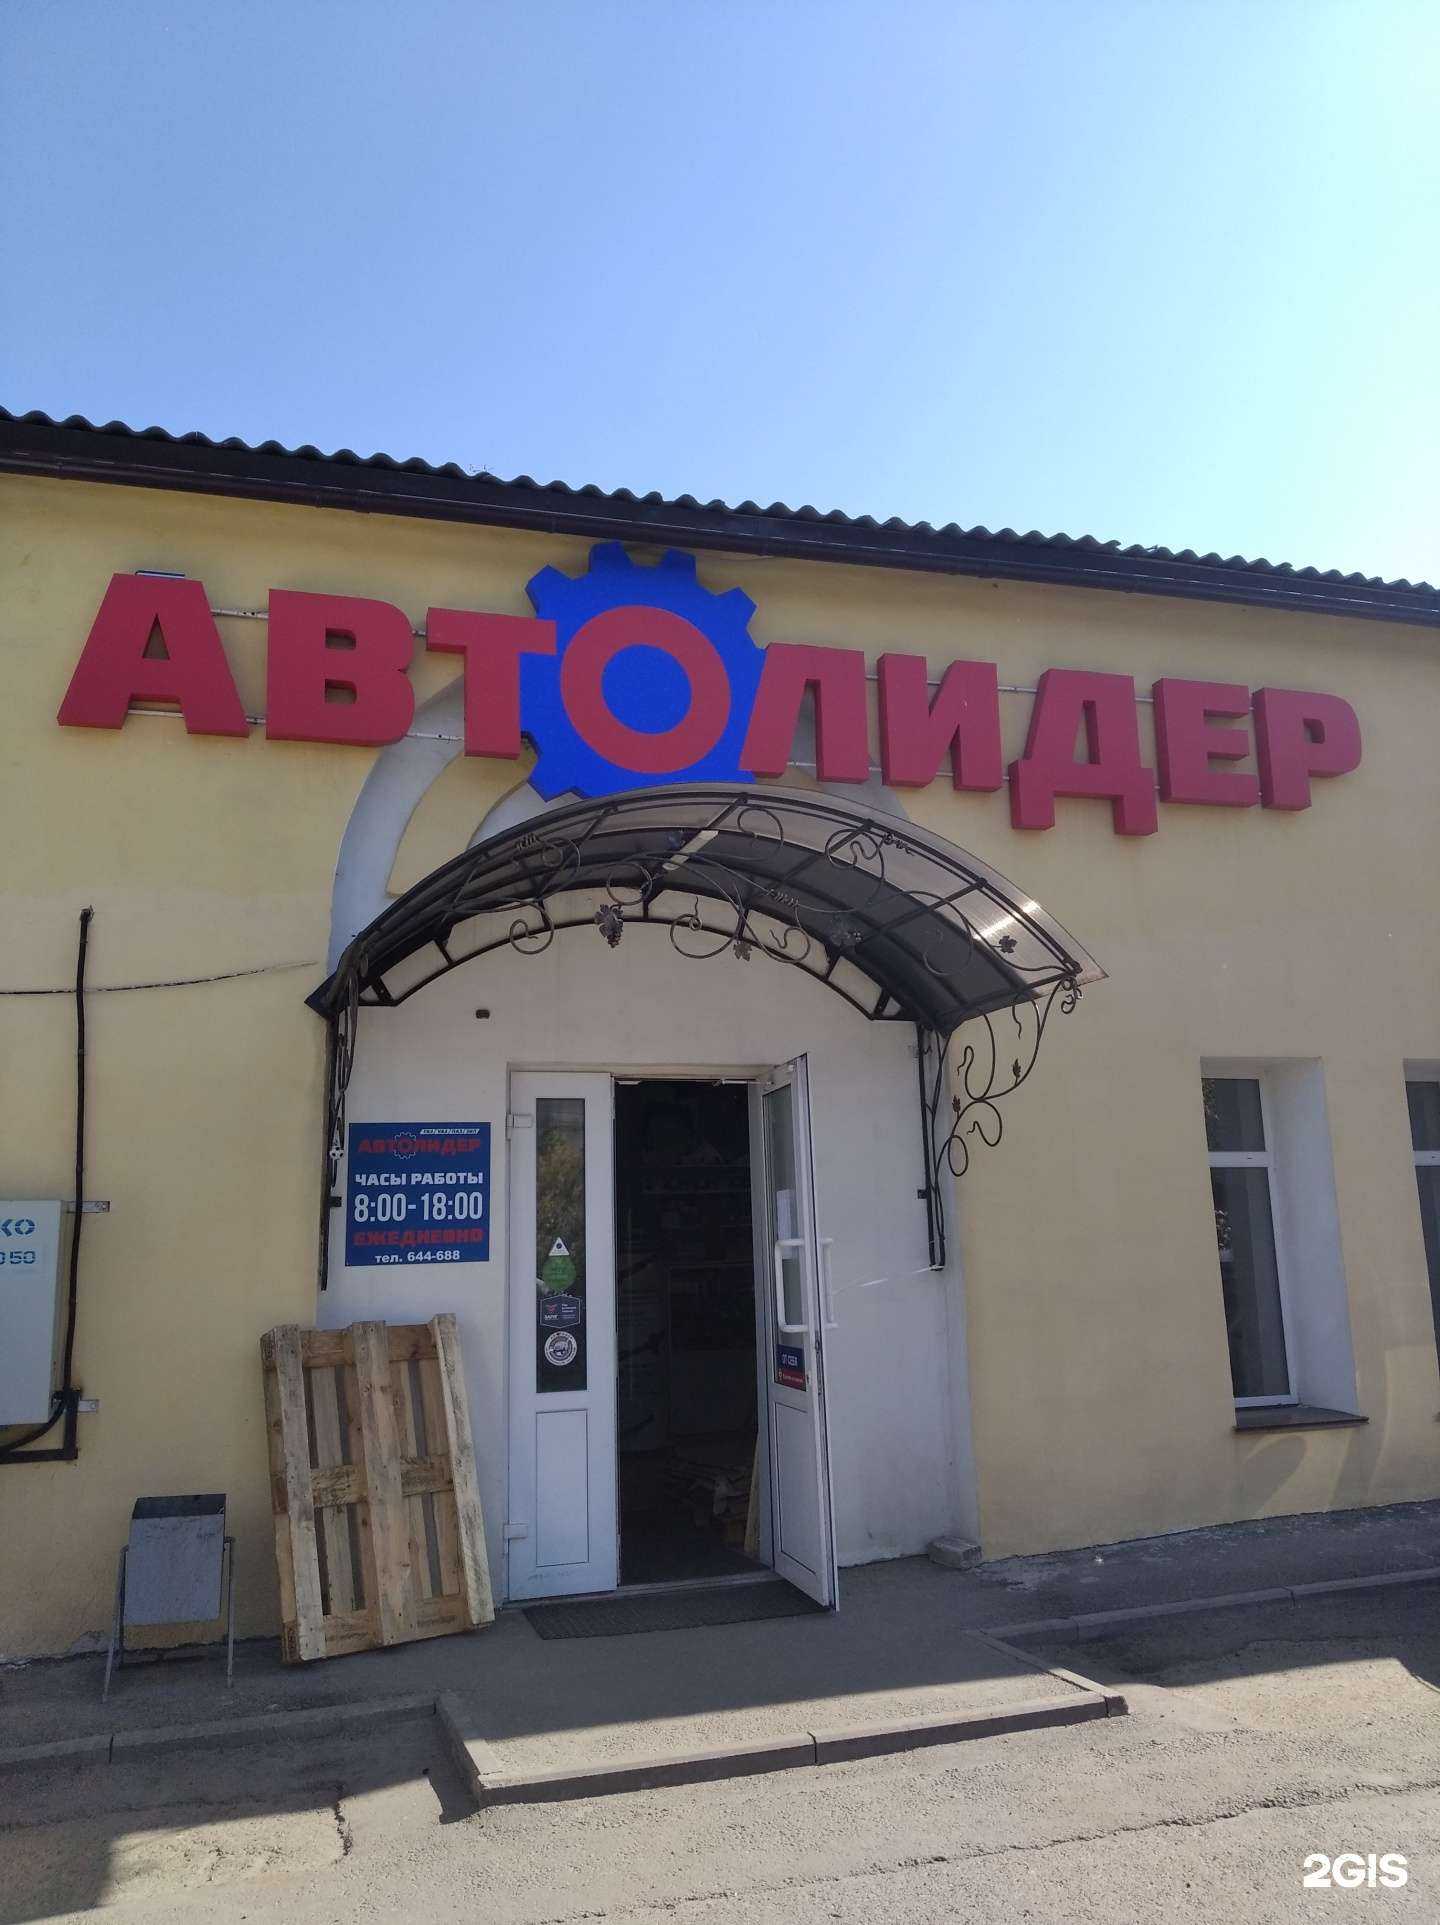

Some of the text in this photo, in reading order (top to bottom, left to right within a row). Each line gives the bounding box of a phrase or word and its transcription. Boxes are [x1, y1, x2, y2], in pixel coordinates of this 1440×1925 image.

[57, 571, 1363, 836] АВТОЛИДЕР
[358, 1137, 481, 1156] АВТОЛИДЕР
[355, 1172, 484, 1186] ЧАСЫ РАБОТЫ
[353, 1228, 483, 1248] ЕЖЕДНЕВНО
[375, 1250, 461, 1264] тел. 644-688
